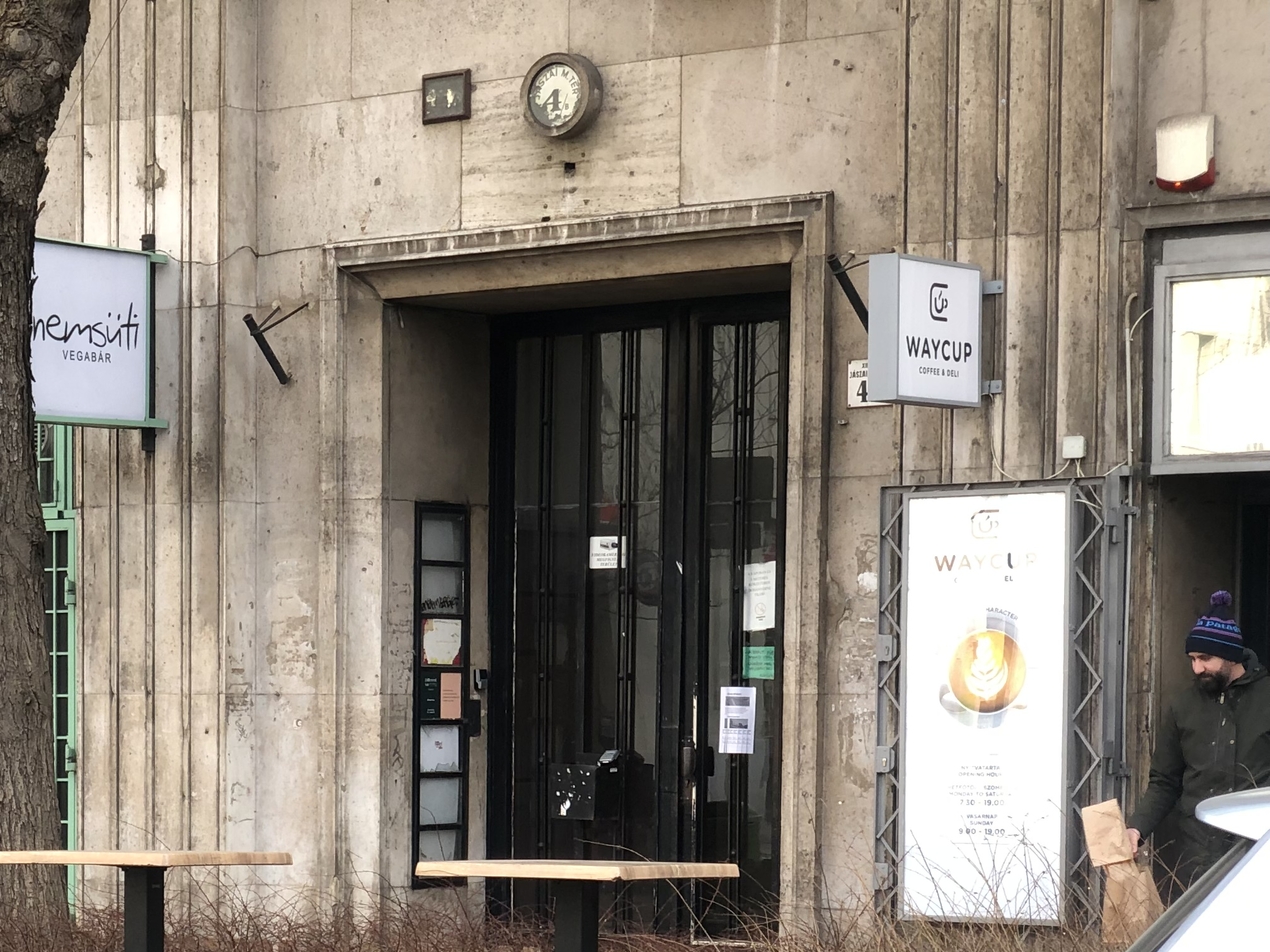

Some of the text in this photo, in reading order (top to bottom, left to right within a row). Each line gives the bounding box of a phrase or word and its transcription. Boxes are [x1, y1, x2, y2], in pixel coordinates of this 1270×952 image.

[32, 302, 140, 351] nemsüti
[62, 349, 112, 364] VEGABÁR
[905, 335, 973, 363] WAYCUP
[918, 366, 960, 378] COFFEE & DELI
[856, 380, 868, 403] 4
[985, 607, 1019, 621] HARACTER
